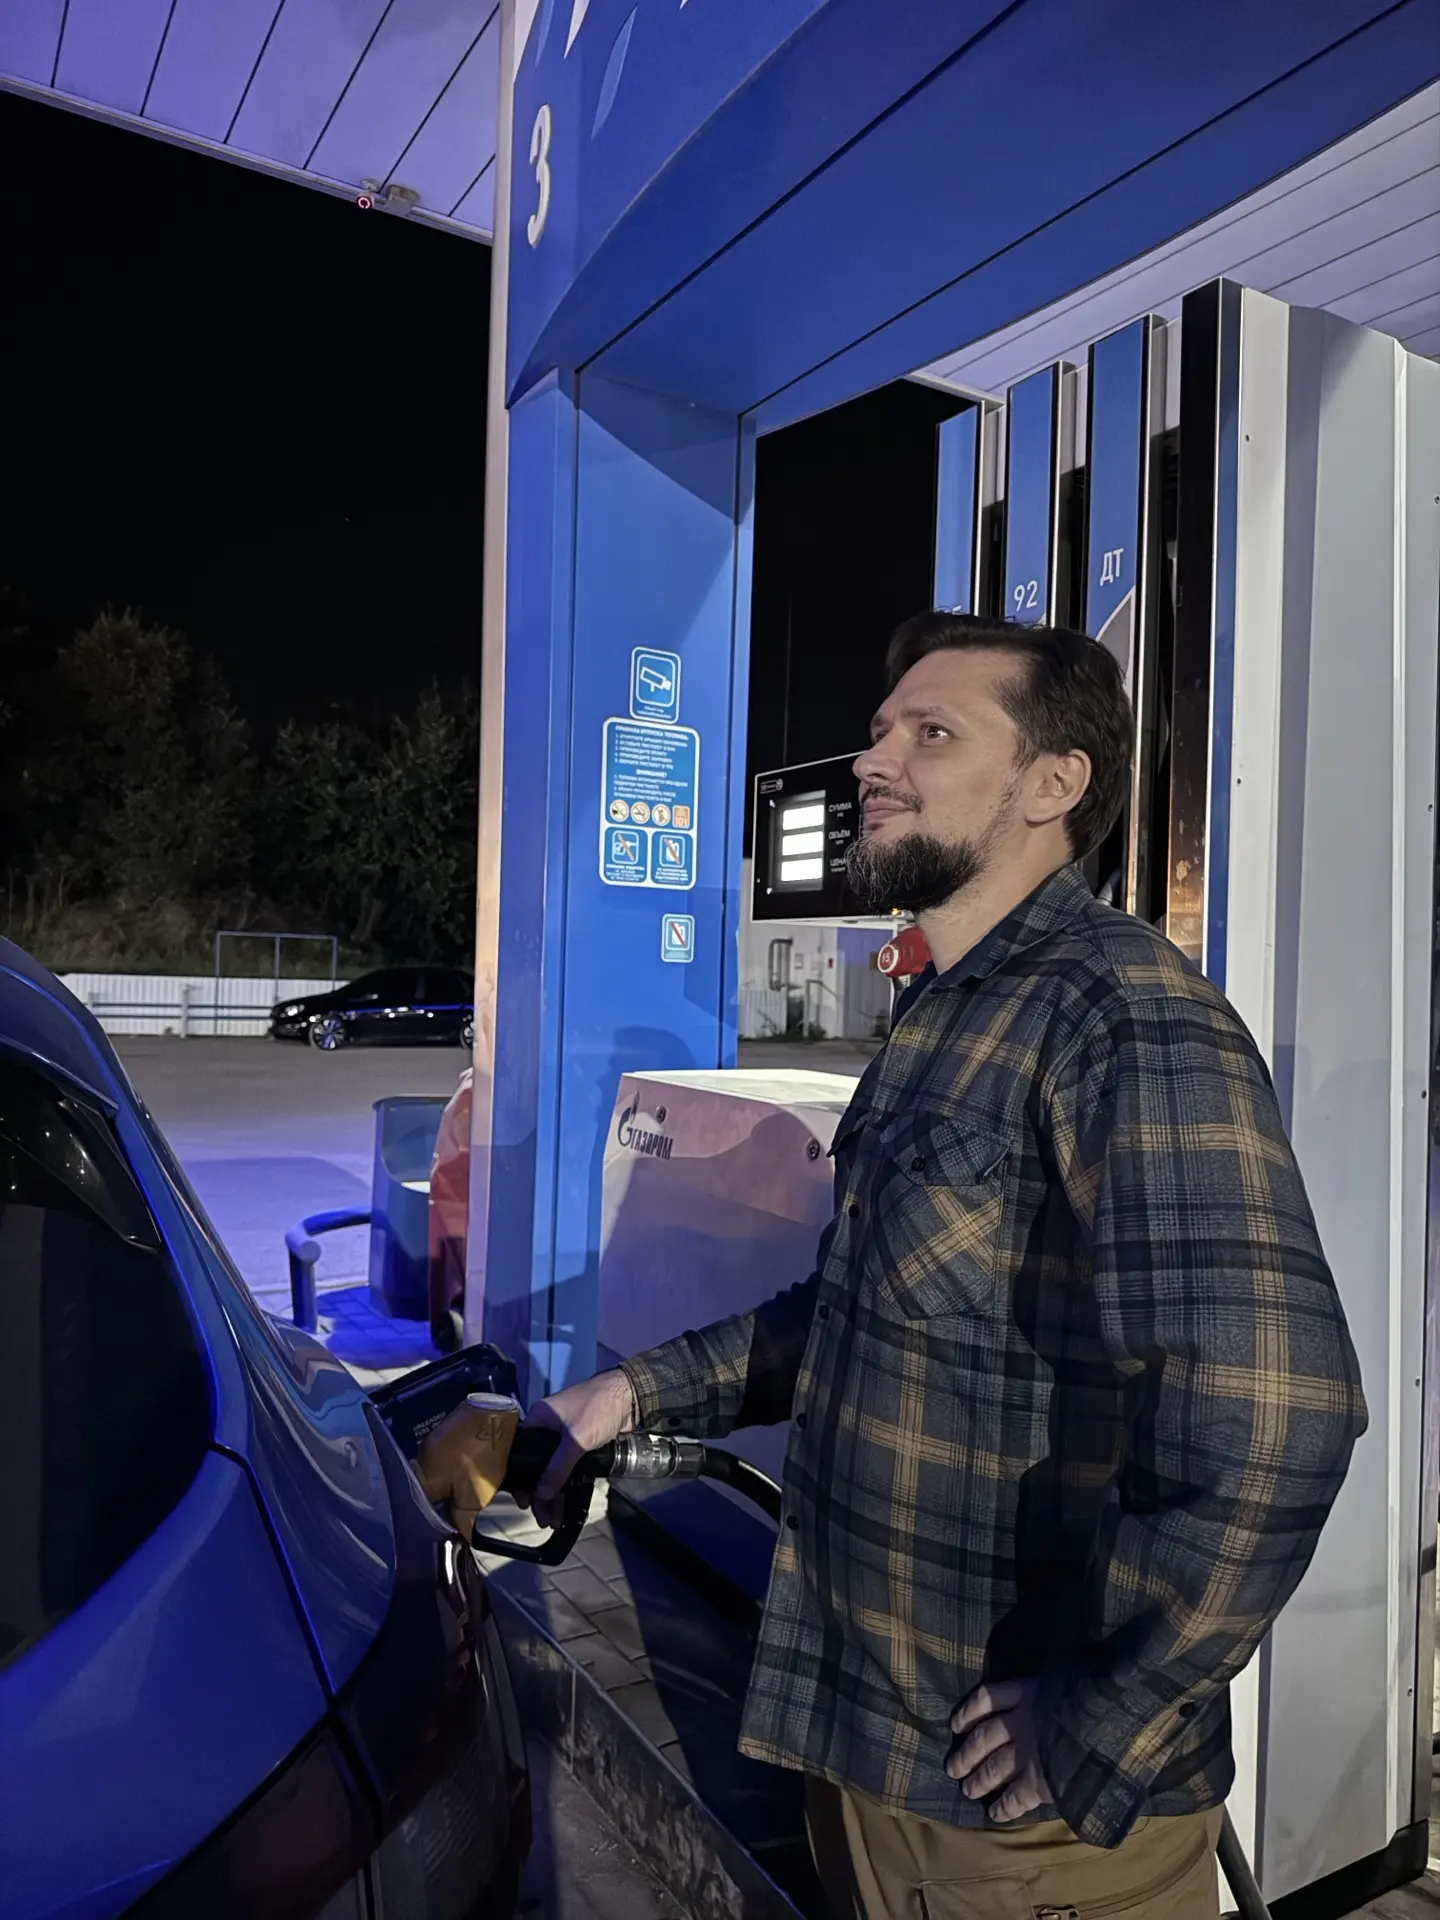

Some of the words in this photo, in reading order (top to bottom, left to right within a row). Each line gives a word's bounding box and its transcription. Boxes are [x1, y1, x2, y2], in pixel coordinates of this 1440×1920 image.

[528, 104, 551, 248] 3
[1099, 548, 1125, 587] ДТ
[1013, 579, 1039, 612] 92
[828, 802, 852, 812] СУММА
[828, 829, 851, 839] ОБЪЁМ
[630, 1128, 673, 1160] ГАЗПРОМ
